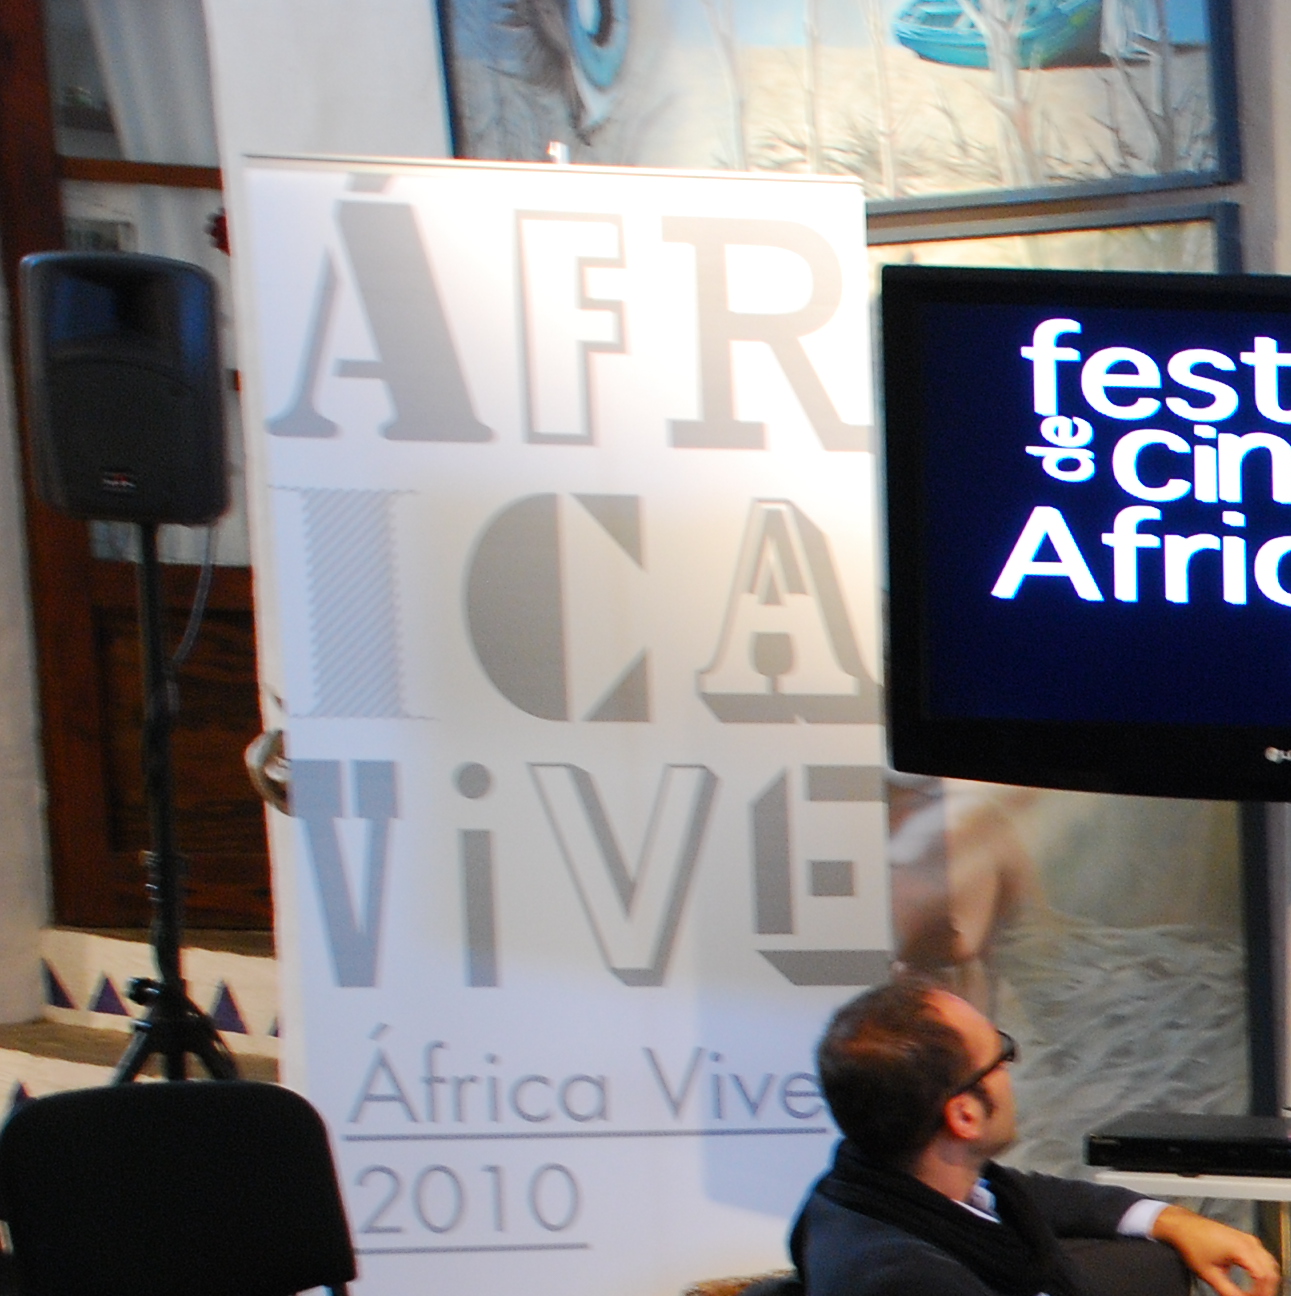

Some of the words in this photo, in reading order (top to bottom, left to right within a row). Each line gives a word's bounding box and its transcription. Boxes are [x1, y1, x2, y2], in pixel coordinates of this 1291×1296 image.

[1026, 415, 1095, 483] de
[347, 1022, 611, 1124] África
[642, 1045, 826, 1121] Vive
[355, 1162, 581, 1235] 2010
